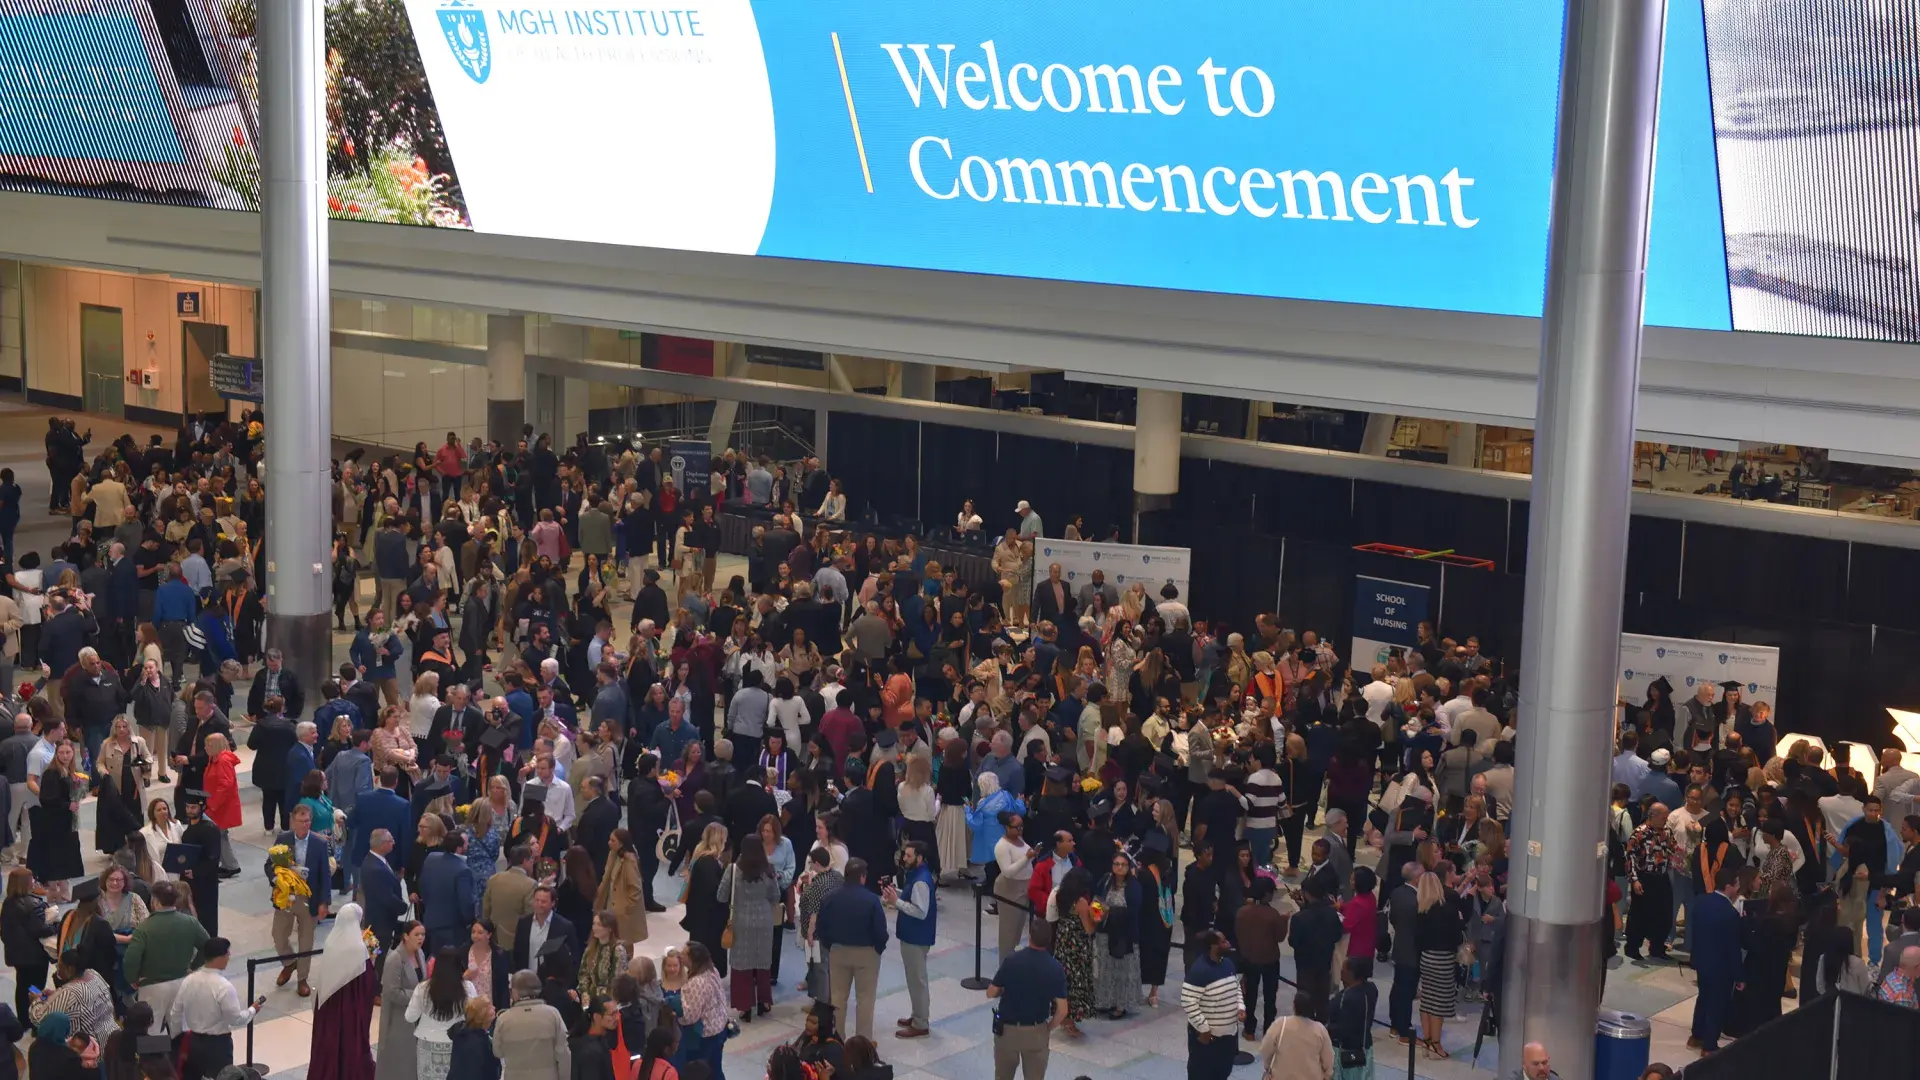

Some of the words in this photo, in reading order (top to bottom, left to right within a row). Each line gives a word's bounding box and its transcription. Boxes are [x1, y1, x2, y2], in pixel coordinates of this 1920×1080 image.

[497, 9, 558, 35] MGH
[564, 9, 704, 37] INSTITUTE
[881, 40, 1185, 116] Welcome
[1197, 57, 1275, 118] to
[909, 136, 1480, 228] Commencement
[1376, 593, 1406, 605] SCHOOL
[1385, 607, 1395, 616] OF
[1373, 617, 1407, 630] NURSING
